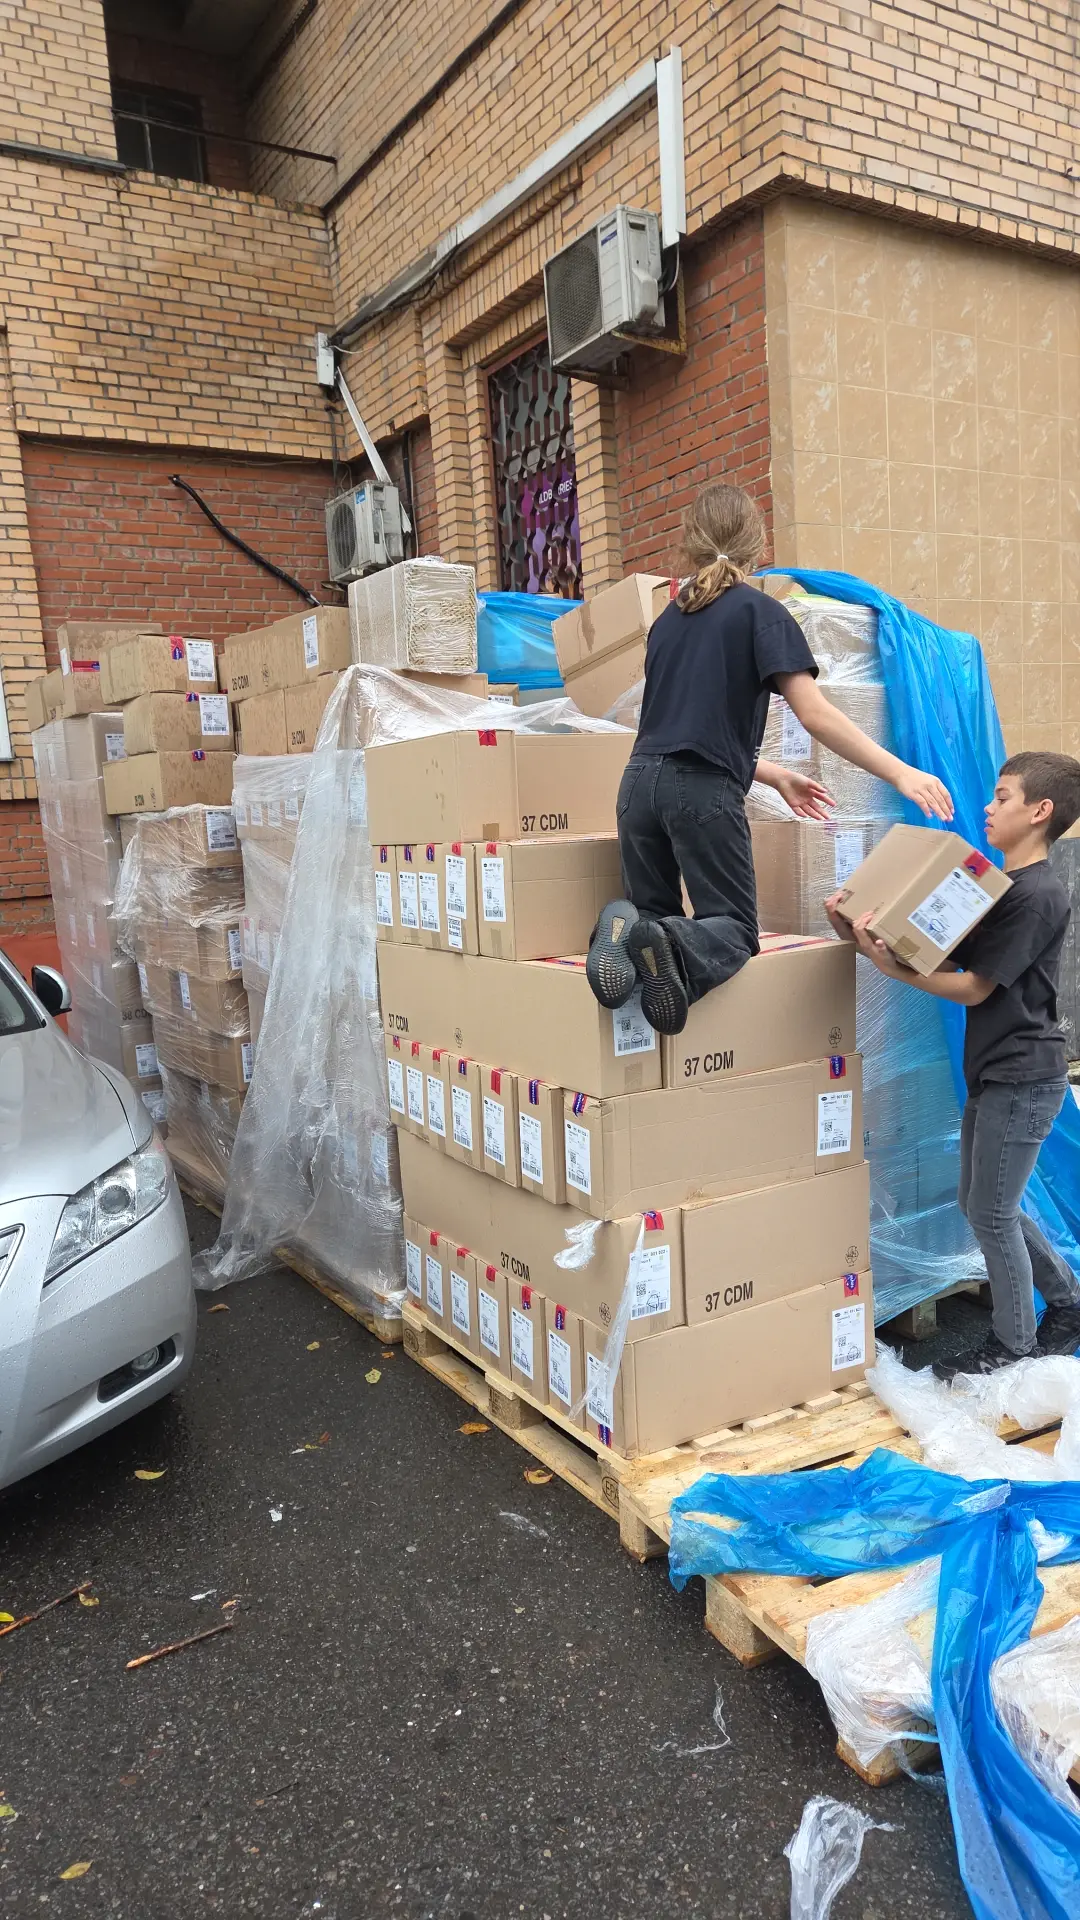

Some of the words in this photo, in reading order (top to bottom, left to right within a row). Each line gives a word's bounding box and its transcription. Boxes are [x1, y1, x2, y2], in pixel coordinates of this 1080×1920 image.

[521, 815, 536, 832] 37
[540, 813, 568, 831] CDM
[388, 1013, 395, 1029] 37
[395, 1015, 410, 1033] CDM
[684, 1056, 700, 1077] 37
[703, 1049, 734, 1074] CDM
[500, 1251, 509, 1270] 37
[511, 1257, 531, 1282] CDM
[705, 1291, 720, 1313] 37
[723, 1280, 754, 1307] CDM
